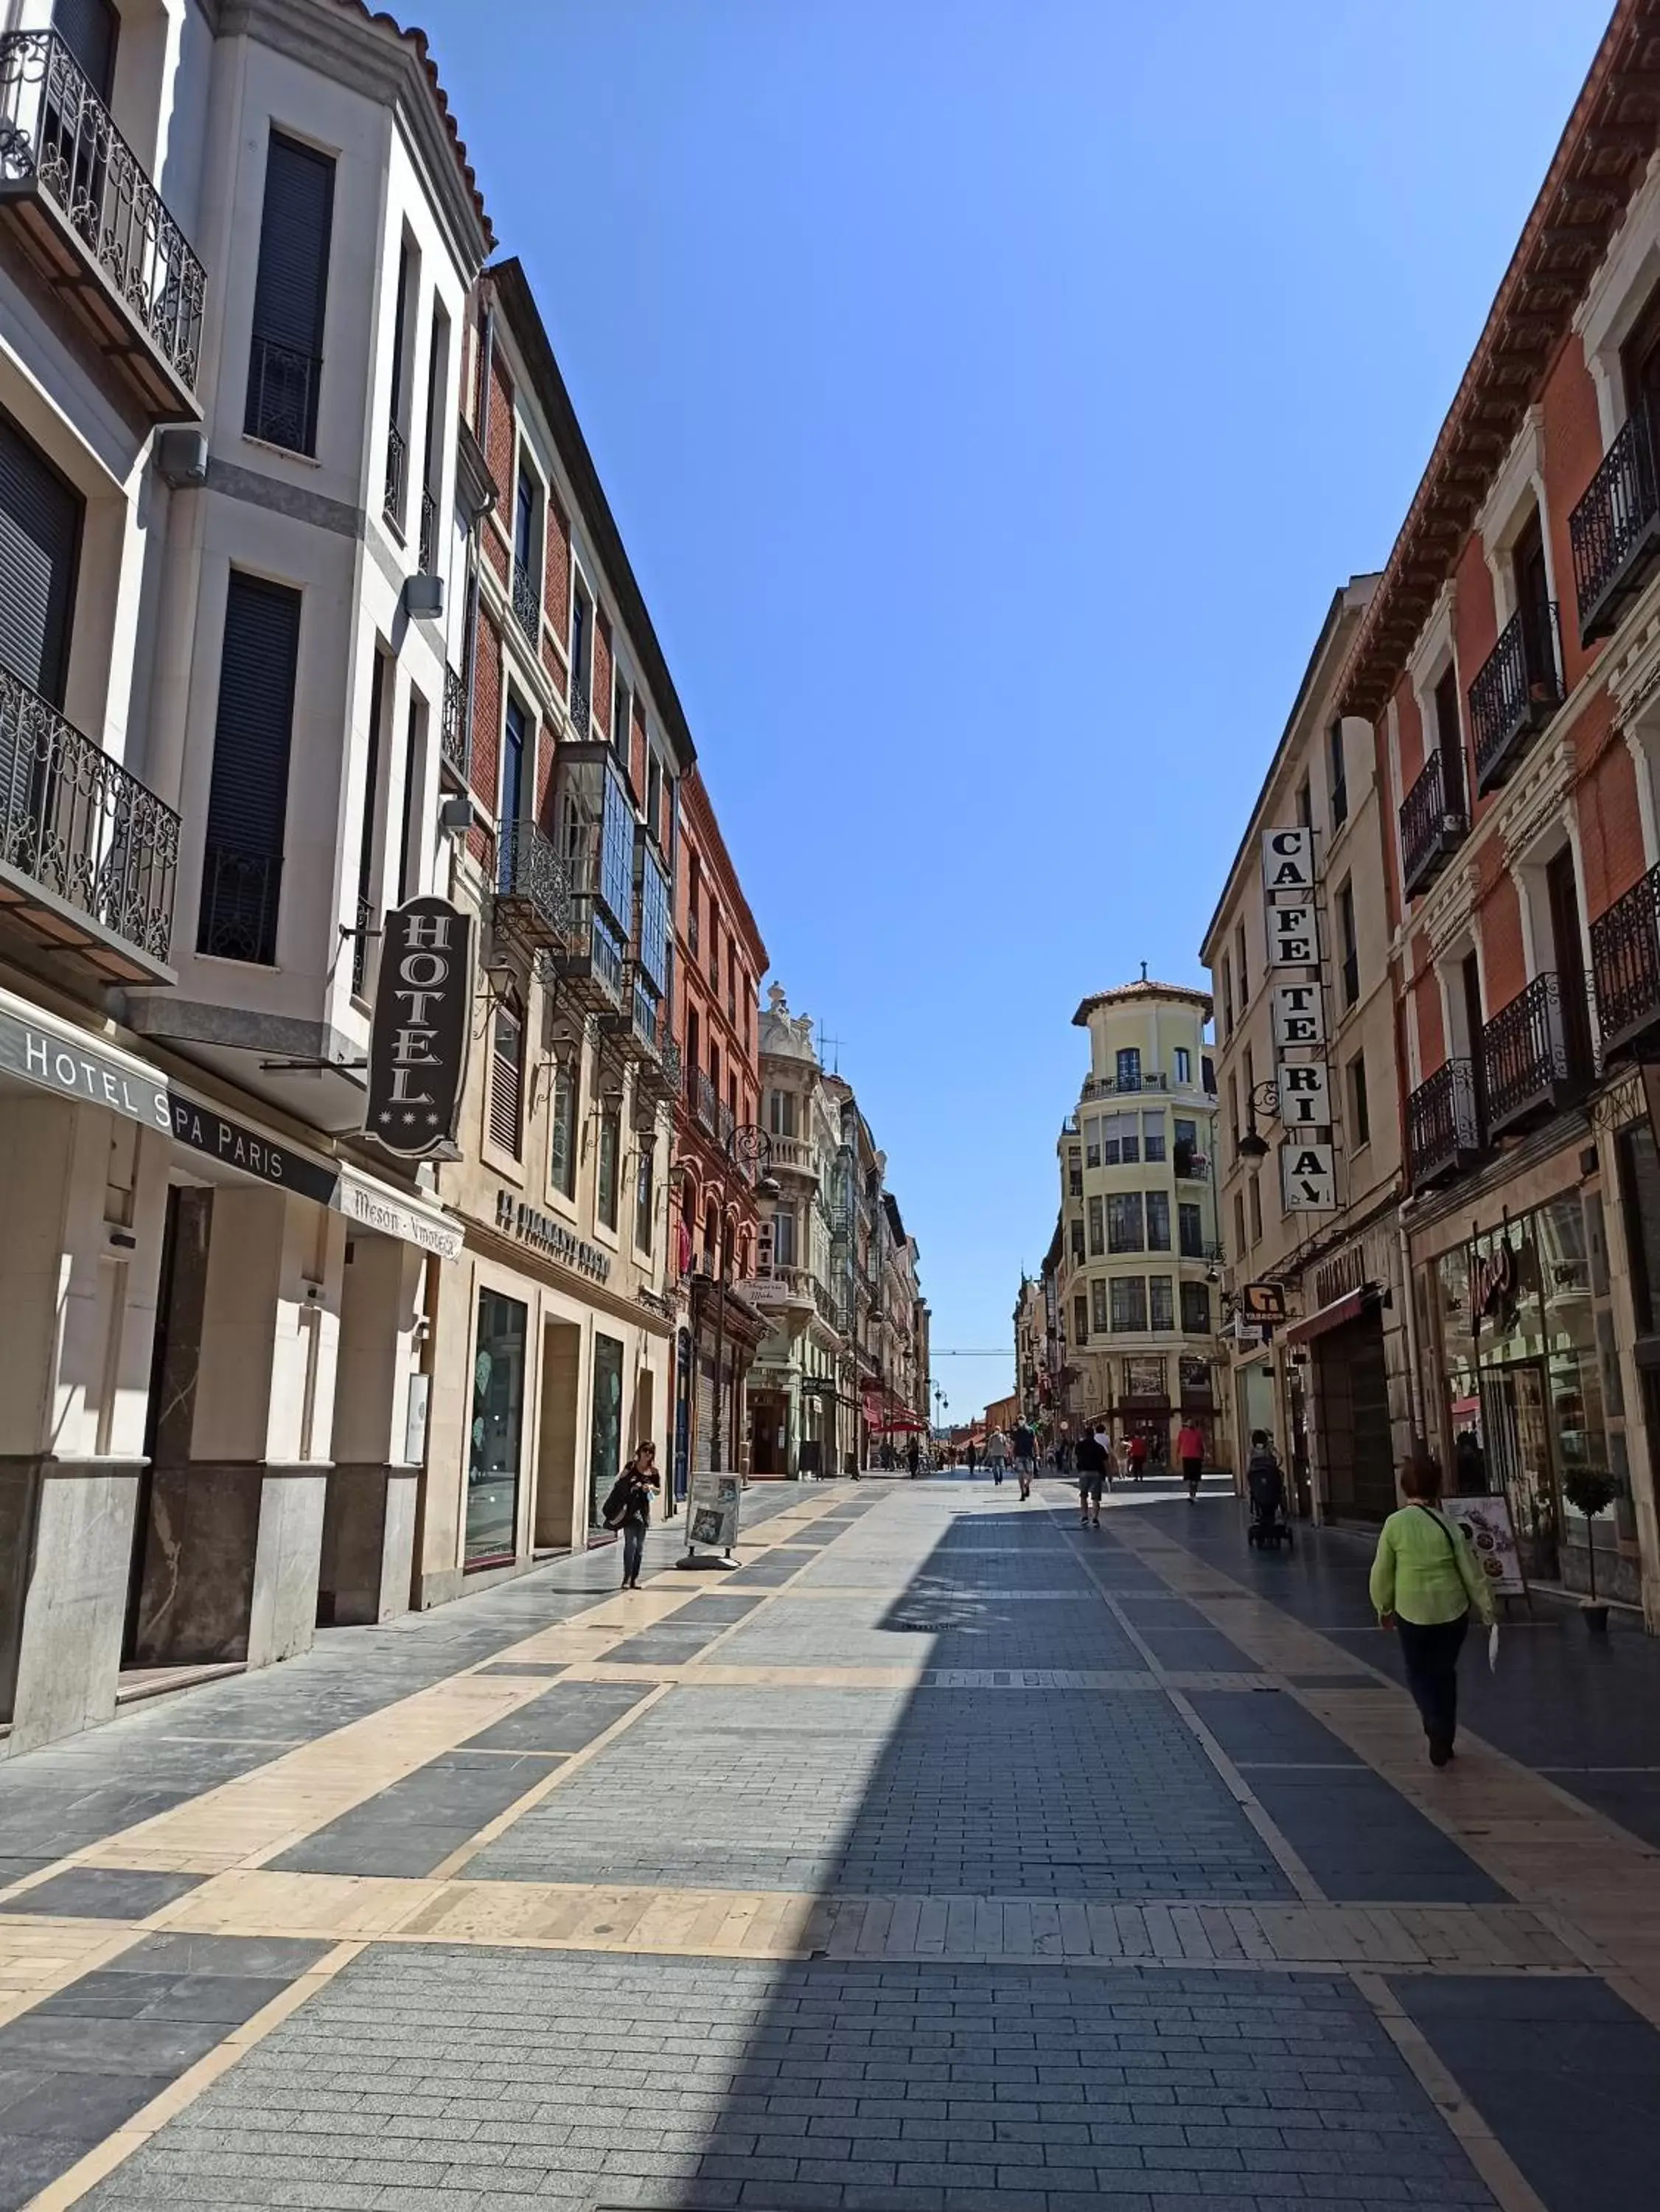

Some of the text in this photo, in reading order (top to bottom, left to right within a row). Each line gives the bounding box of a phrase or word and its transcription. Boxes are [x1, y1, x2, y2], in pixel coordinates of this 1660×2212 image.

[390, 914, 451, 1106] HOTEL
[1272, 832, 1327, 1175] CAFETERIA
[25, 1032, 283, 1178] HOTEL SPA PARIS
[355, 1189, 399, 1231] Mesón
[756, 1224, 773, 1278] IRIS
